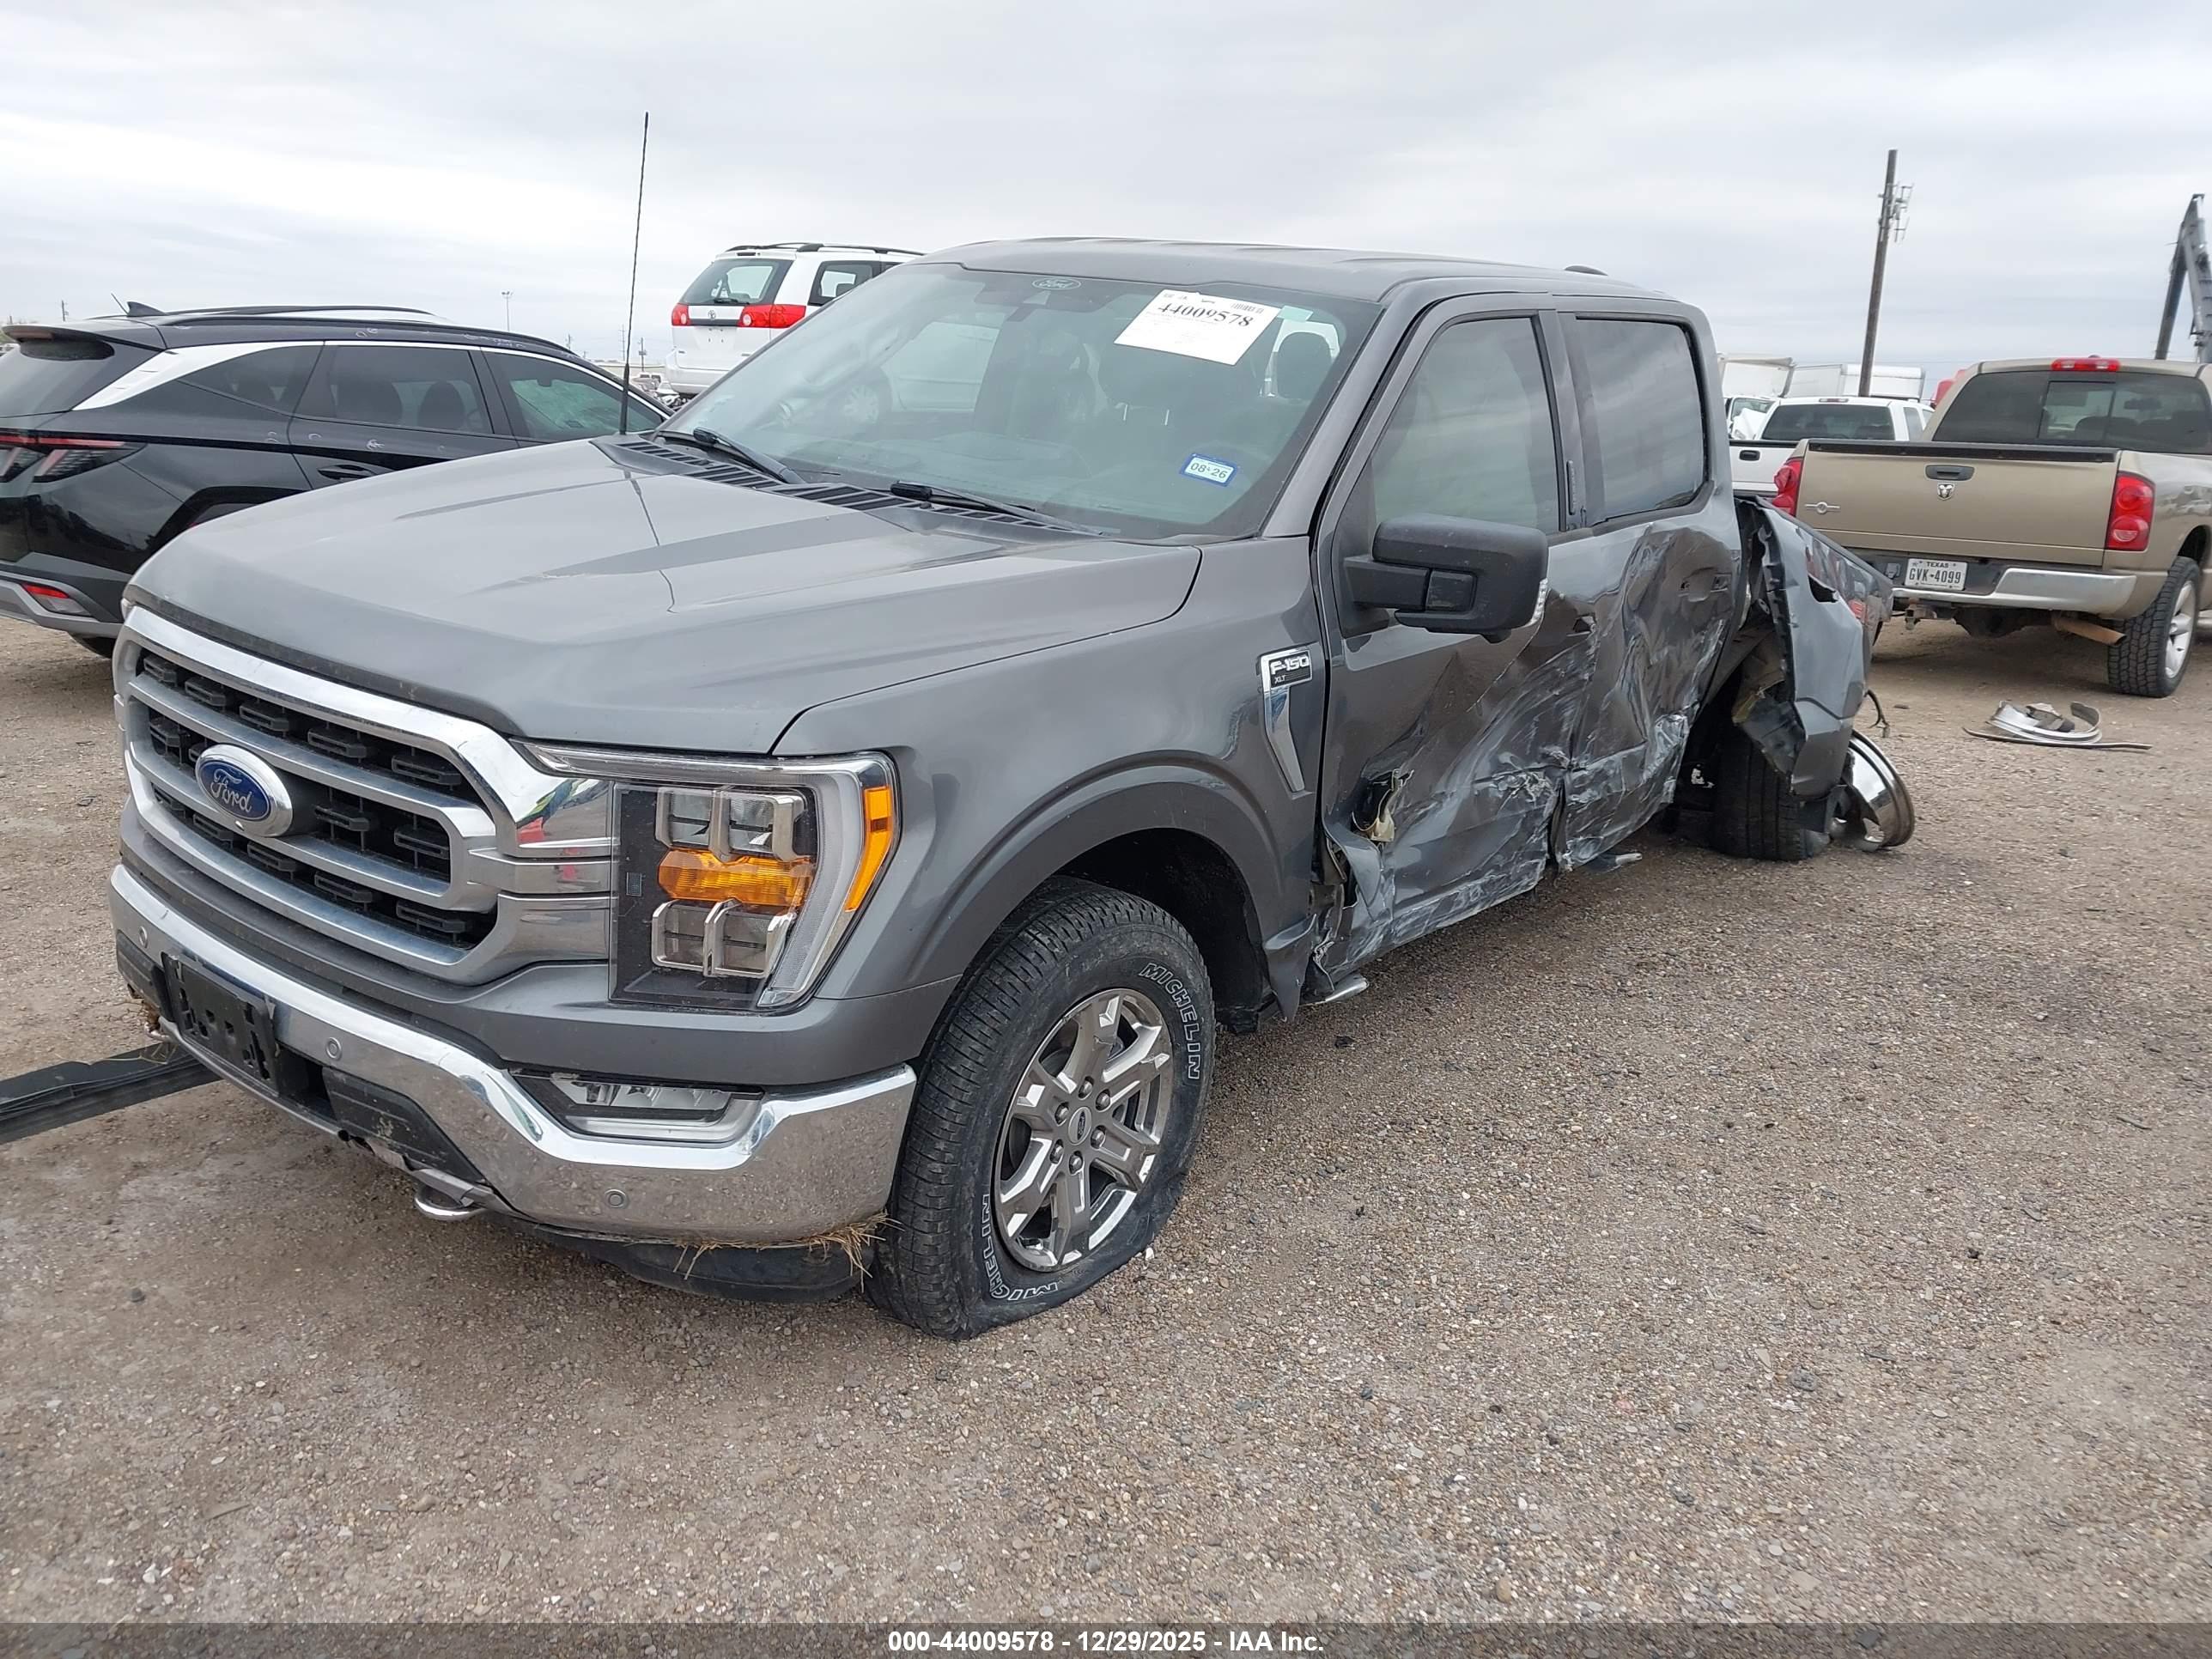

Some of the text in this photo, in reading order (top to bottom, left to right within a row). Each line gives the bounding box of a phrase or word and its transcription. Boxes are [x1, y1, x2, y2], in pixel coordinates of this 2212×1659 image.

[1158, 302, 1254, 326] 44009578
[1190, 462, 1228, 478] 08 26
[1270, 655, 1310, 675] F-150
[1274, 675, 1286, 684] XLT
[210, 769, 252, 812] Ford
[1139, 963, 1201, 1079] MICHELIN
[981, 1194, 1058, 1301] MICHELIN
